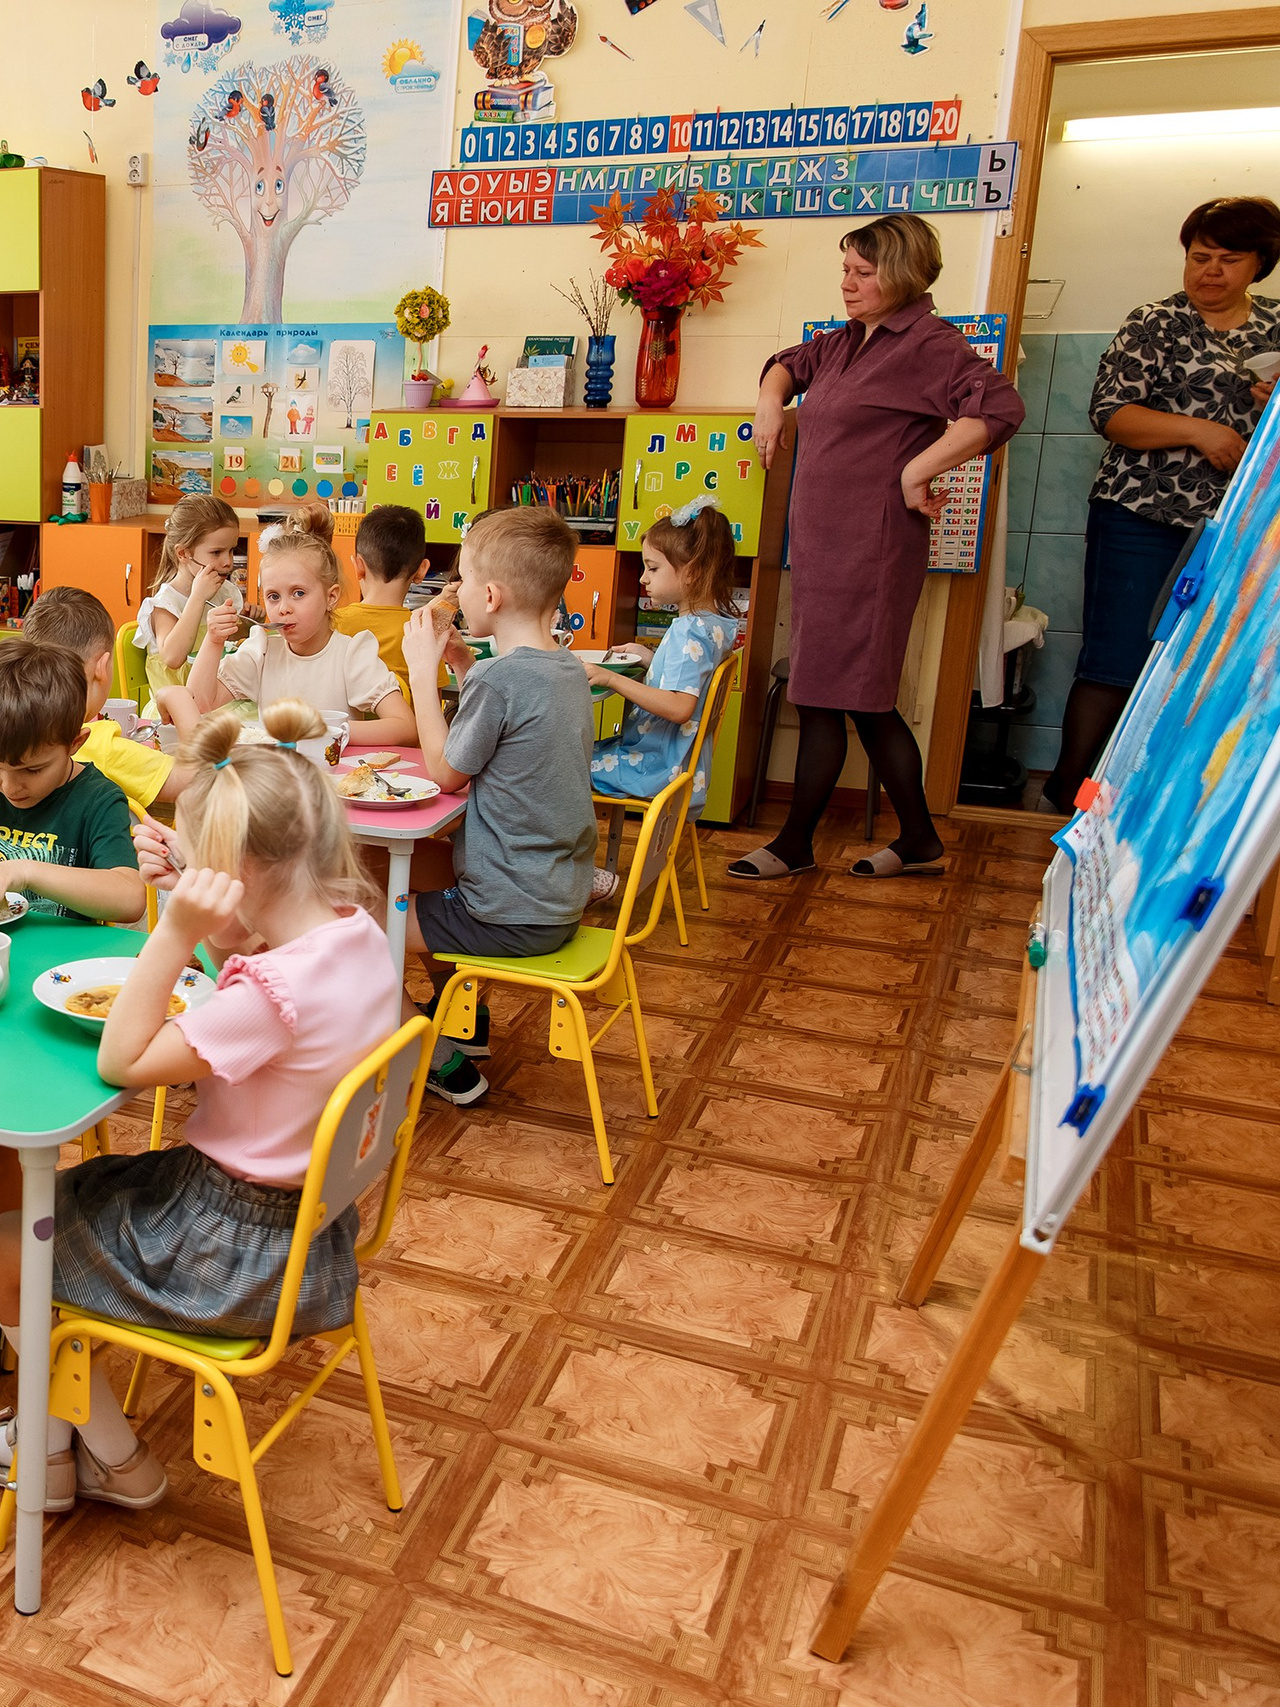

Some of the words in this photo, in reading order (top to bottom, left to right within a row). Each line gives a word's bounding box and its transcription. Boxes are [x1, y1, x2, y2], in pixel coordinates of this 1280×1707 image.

[464, 133, 476, 158] 0
[485, 132, 494, 157] 1
[503, 131, 516, 156] 2
[523, 130, 535, 155] 3
[544, 129, 557, 154] 4
[565, 128, 577, 153] 5
[586, 127, 598, 152] 6
[608, 126, 621, 151] 7
[629, 124, 643, 149] 8
[652, 123, 665, 148] 9
[672, 121, 691, 147] 10
[694, 119, 713, 146] 11
[720, 118, 741, 145] 12
[745, 117, 766, 144] 13
[771, 115, 793, 142] 14
[797, 114, 819, 141] 15
[824, 113, 847, 140] 16
[851, 112, 874, 138] 17
[878, 110, 902, 137] 18
[905, 108, 930, 137] 19
[930, 107, 958, 135] 20
[220, 329, 268, 337] Календарь
[276, 329, 318, 337] природы
[374, 422, 388, 439] А
[399, 429, 412, 446] Б
[423, 421, 437, 439] В
[448, 427, 459, 444] Г
[471, 423, 486, 441] Д
[647, 434, 666, 453] Л
[675, 423, 697, 442] М
[708, 433, 726, 451] Н
[737, 422, 753, 441] О
[227, 455, 243, 468] 19
[386, 464, 397, 481] Е
[413, 464, 423, 486] Ё
[437, 460, 460, 479] Ж
[645, 471, 663, 491] П
[675, 461, 691, 480] Р
[704, 471, 717, 489] С
[737, 460, 751, 479] Т
[426, 498, 440, 519] Й
[624, 521, 640, 540] У
[961, 529, 976, 537] ЦИ
